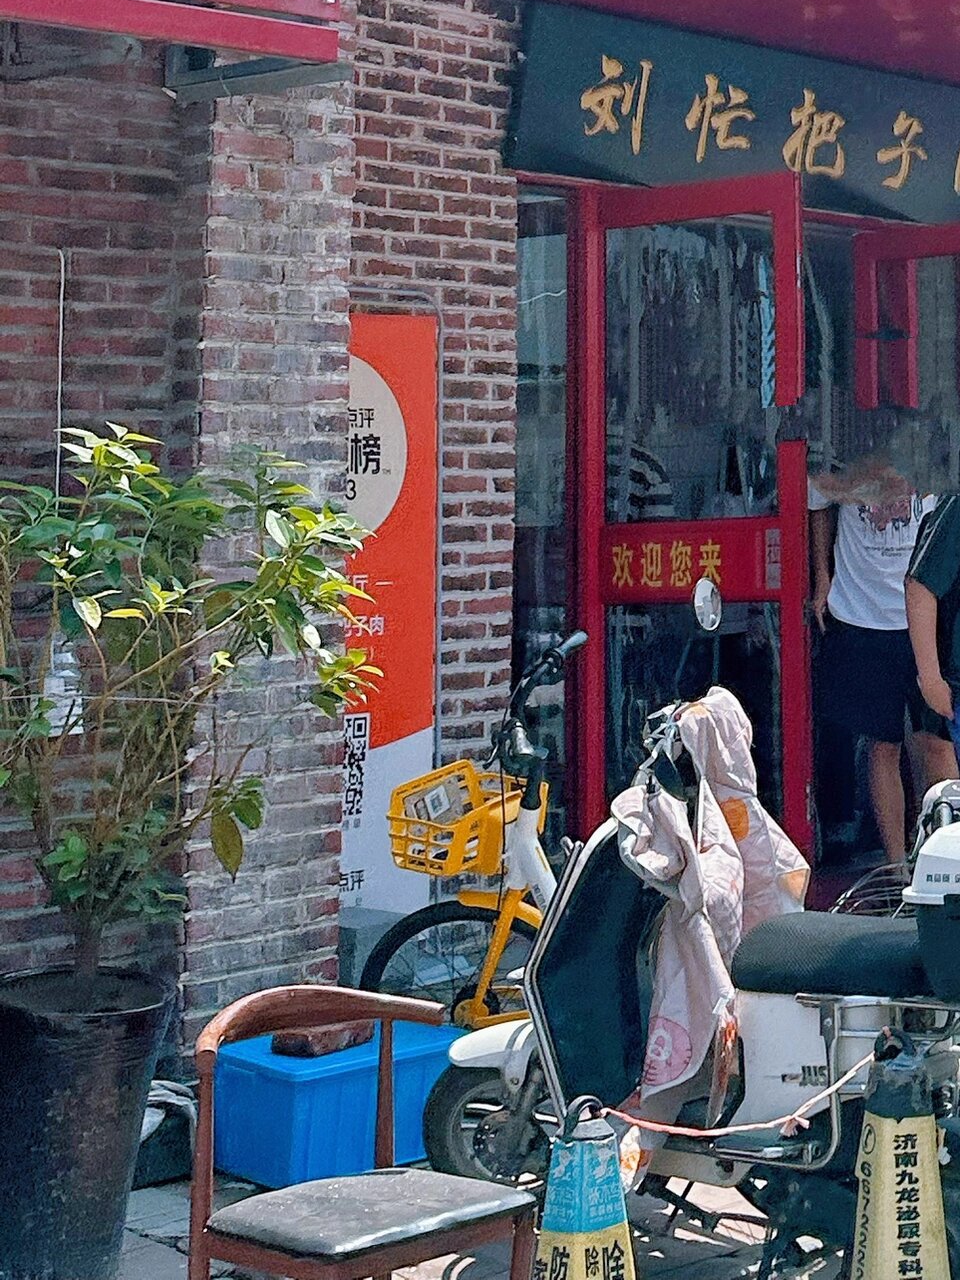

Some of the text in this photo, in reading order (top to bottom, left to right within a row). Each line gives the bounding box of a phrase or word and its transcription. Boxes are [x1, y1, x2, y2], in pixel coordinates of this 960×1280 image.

[345, 433, 381, 475] 榜
[611, 539, 722, 588] 欢迎您来
[893, 1133, 923, 1280] 济南九龙泌尿专科
